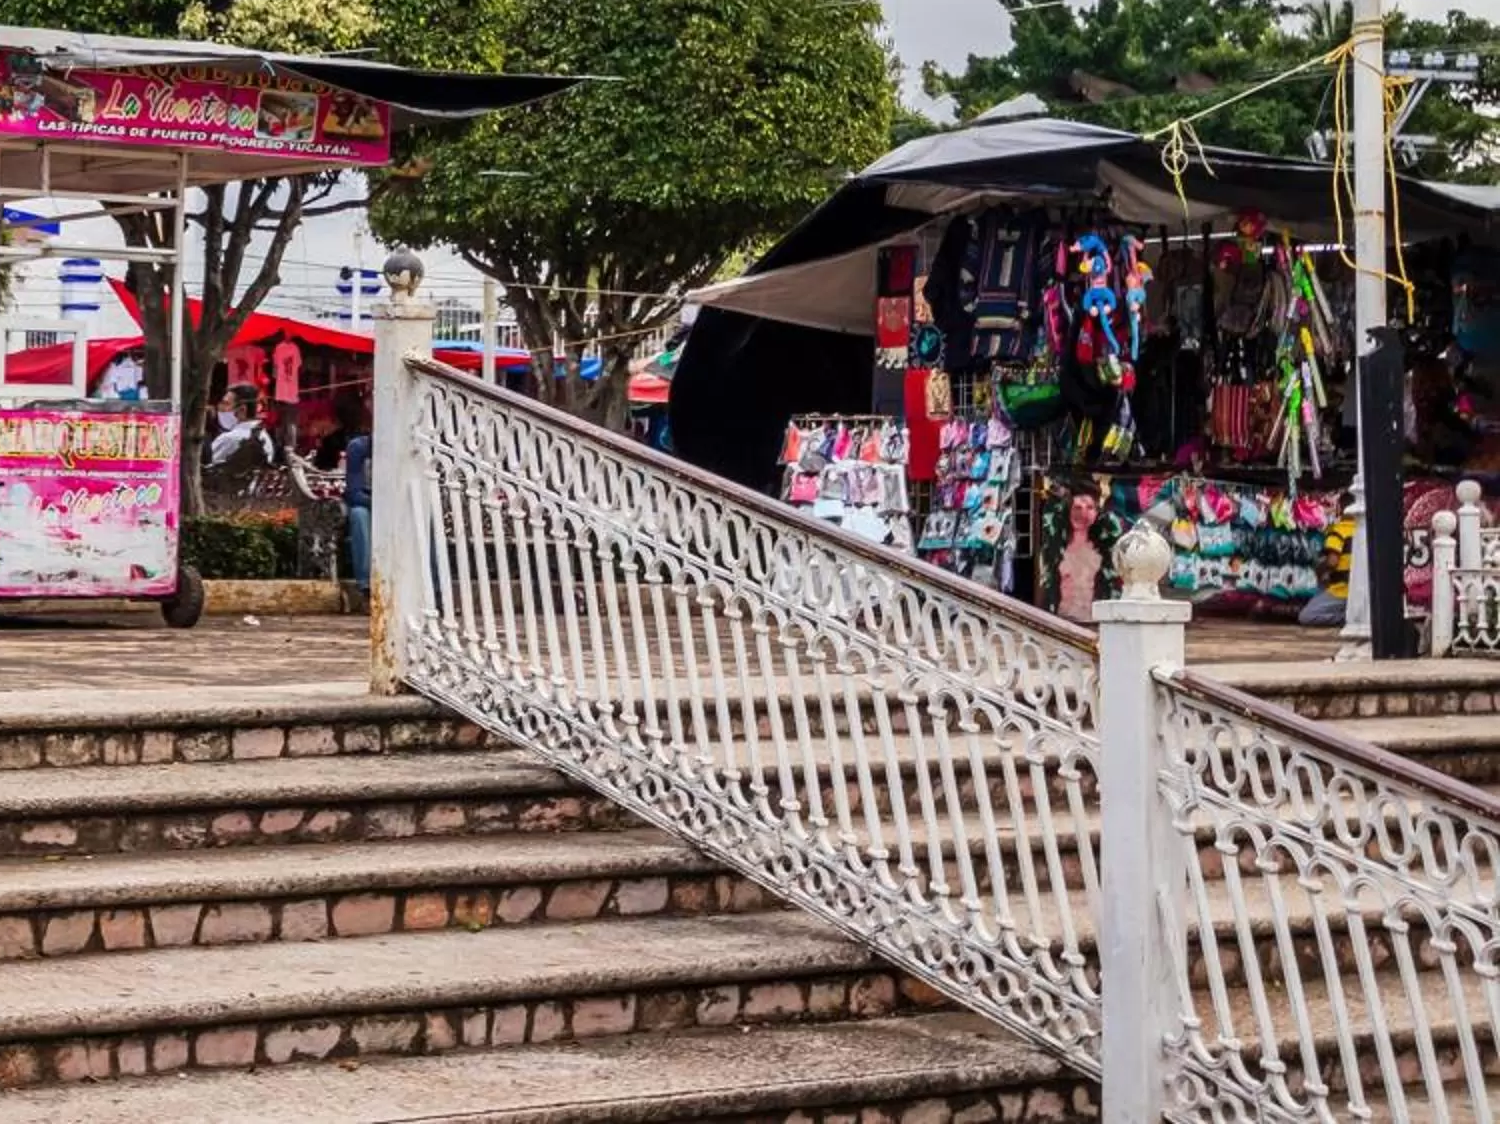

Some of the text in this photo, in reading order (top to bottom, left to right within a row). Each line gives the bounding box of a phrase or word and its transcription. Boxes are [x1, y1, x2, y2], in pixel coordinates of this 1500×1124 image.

[102, 79, 258, 130] La Yucateca
[37, 120, 67, 132] LAS
[130, 126, 148, 138] DE
[151, 129, 208, 142] PUERTO
[211, 132, 285, 151] PROGRESO
